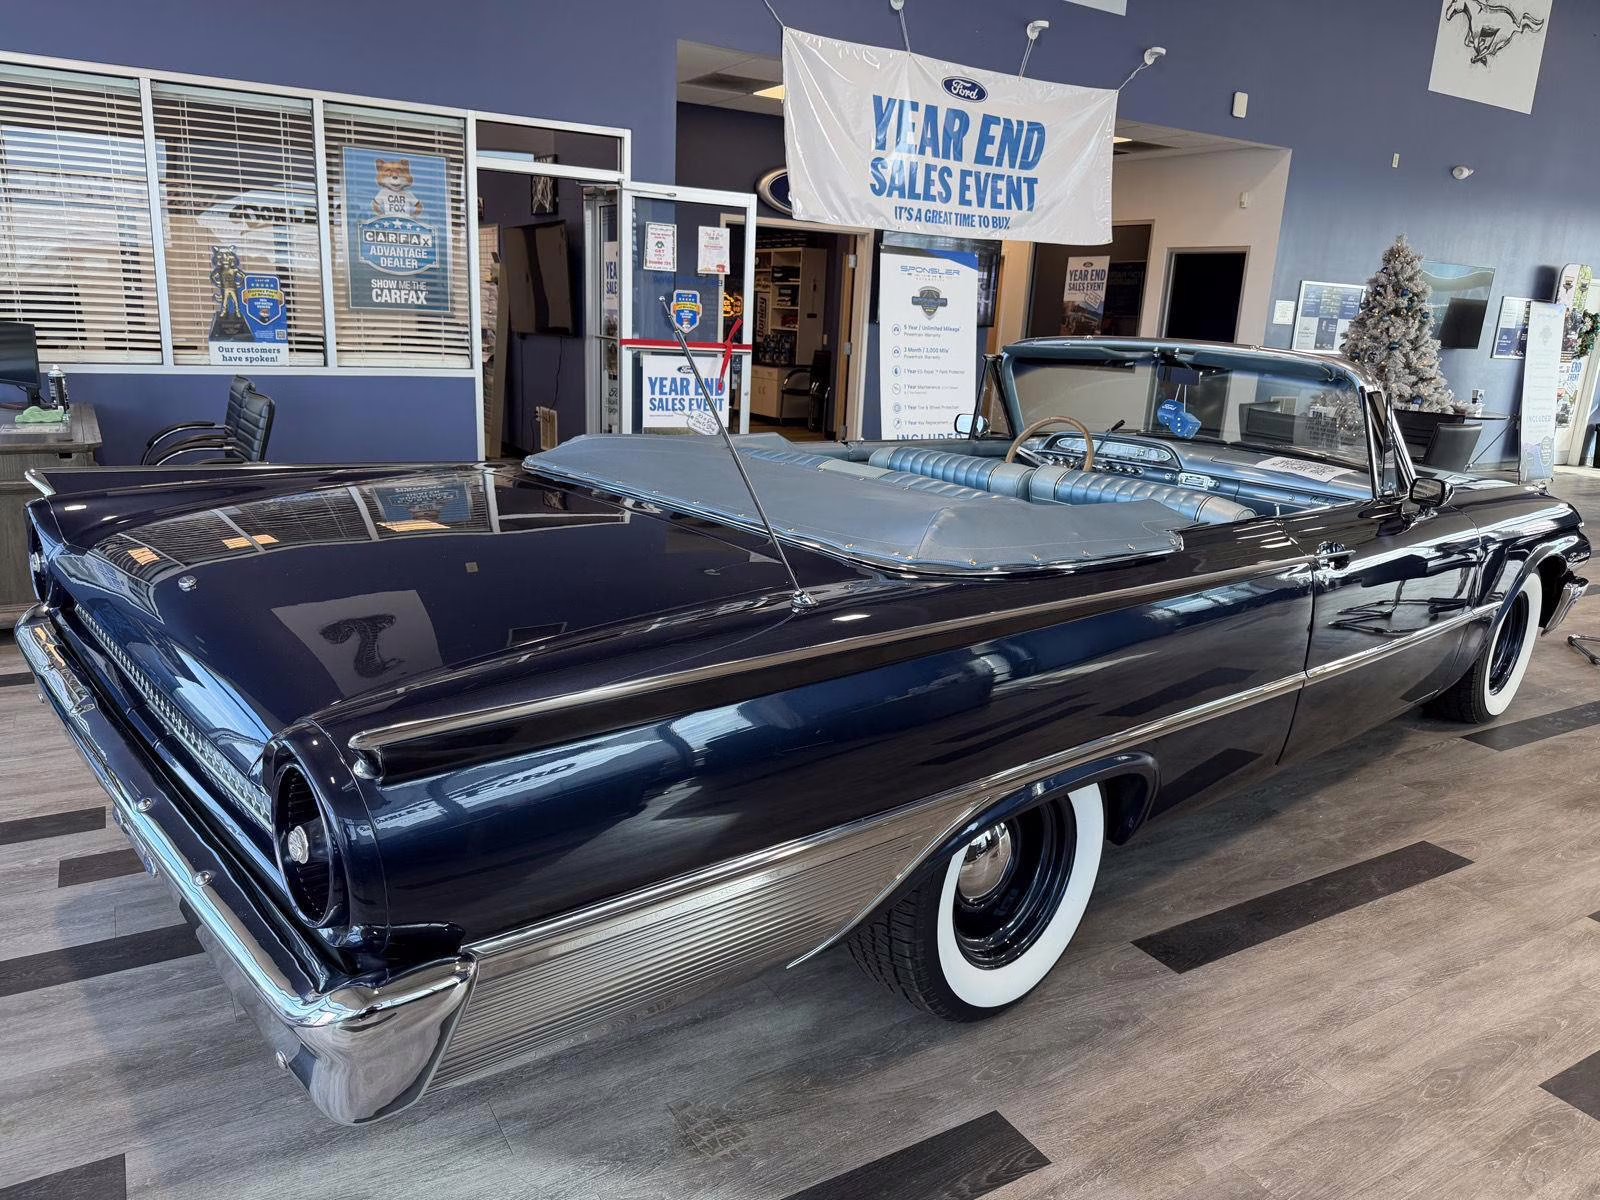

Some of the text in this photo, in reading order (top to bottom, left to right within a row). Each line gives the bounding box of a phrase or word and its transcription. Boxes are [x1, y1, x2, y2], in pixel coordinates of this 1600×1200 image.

[951, 79, 979, 100] Ford
[872, 95, 1046, 171] YEAR END
[869, 156, 1039, 213] SALES EVENT
[387, 194, 406, 203] CAR
[389, 203, 405, 213] FOX
[894, 205, 913, 220] IT'S
[914, 208, 922, 222] A
[924, 209, 952, 225] GREAT
[954, 212, 976, 228] TIME
[978, 215, 989, 228] TO
[365, 232, 431, 247] CARFAX
[369, 246, 428, 259] ADVANTAGE
[380, 257, 418, 269] DEALER
[900, 265, 960, 276] SPONSLER
[1069, 269, 1089, 282] YEAR
[1090, 269, 1107, 282] END
[371, 278, 427, 290] SHOW ME THE
[1068, 282, 1105, 291] SALES EVENT
[372, 289, 428, 305] CARFAX
[236, 346, 281, 354] customers
[222, 354, 278, 364] have spoken!
[648, 376, 726, 396] YEAR END
[649, 397, 685, 411] SALES
